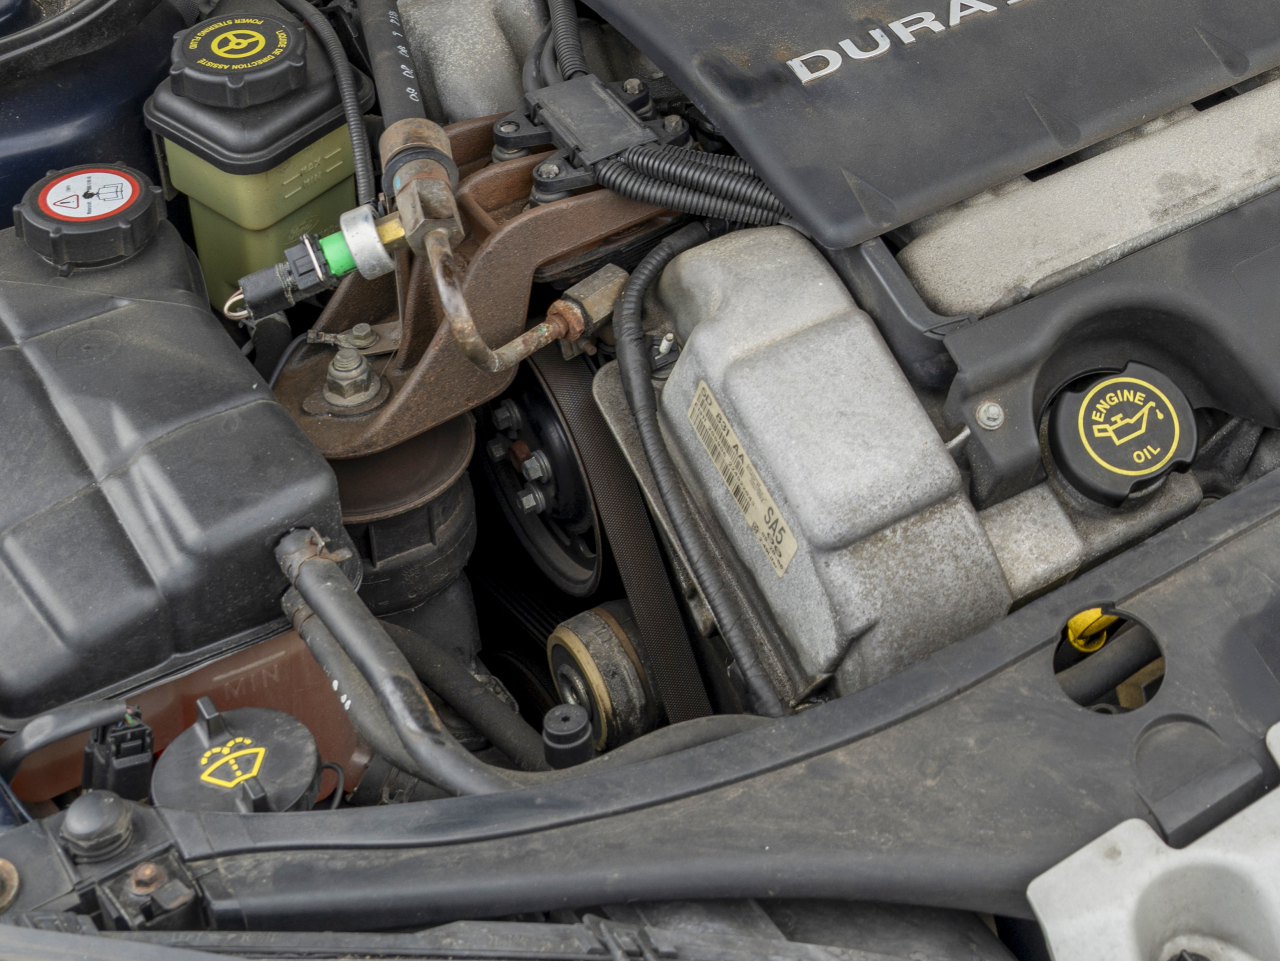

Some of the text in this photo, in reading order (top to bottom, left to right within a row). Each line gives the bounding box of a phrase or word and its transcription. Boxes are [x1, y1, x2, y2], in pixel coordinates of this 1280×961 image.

[197, 20, 232, 37] STEERING
[189, 34, 201, 49] FLUID
[232, 55, 275, 69] DIRECTION
[301, 157, 321, 173] MAX
[1091, 390, 1146, 422] ENGINE
[701, 387, 713, 407] 5D
[716, 413, 730, 437] 831
[732, 443, 745, 465] AA
[1133, 445, 1161, 463] OIL
[764, 506, 785, 546] SA5
[224, 664, 280, 701] MIN
